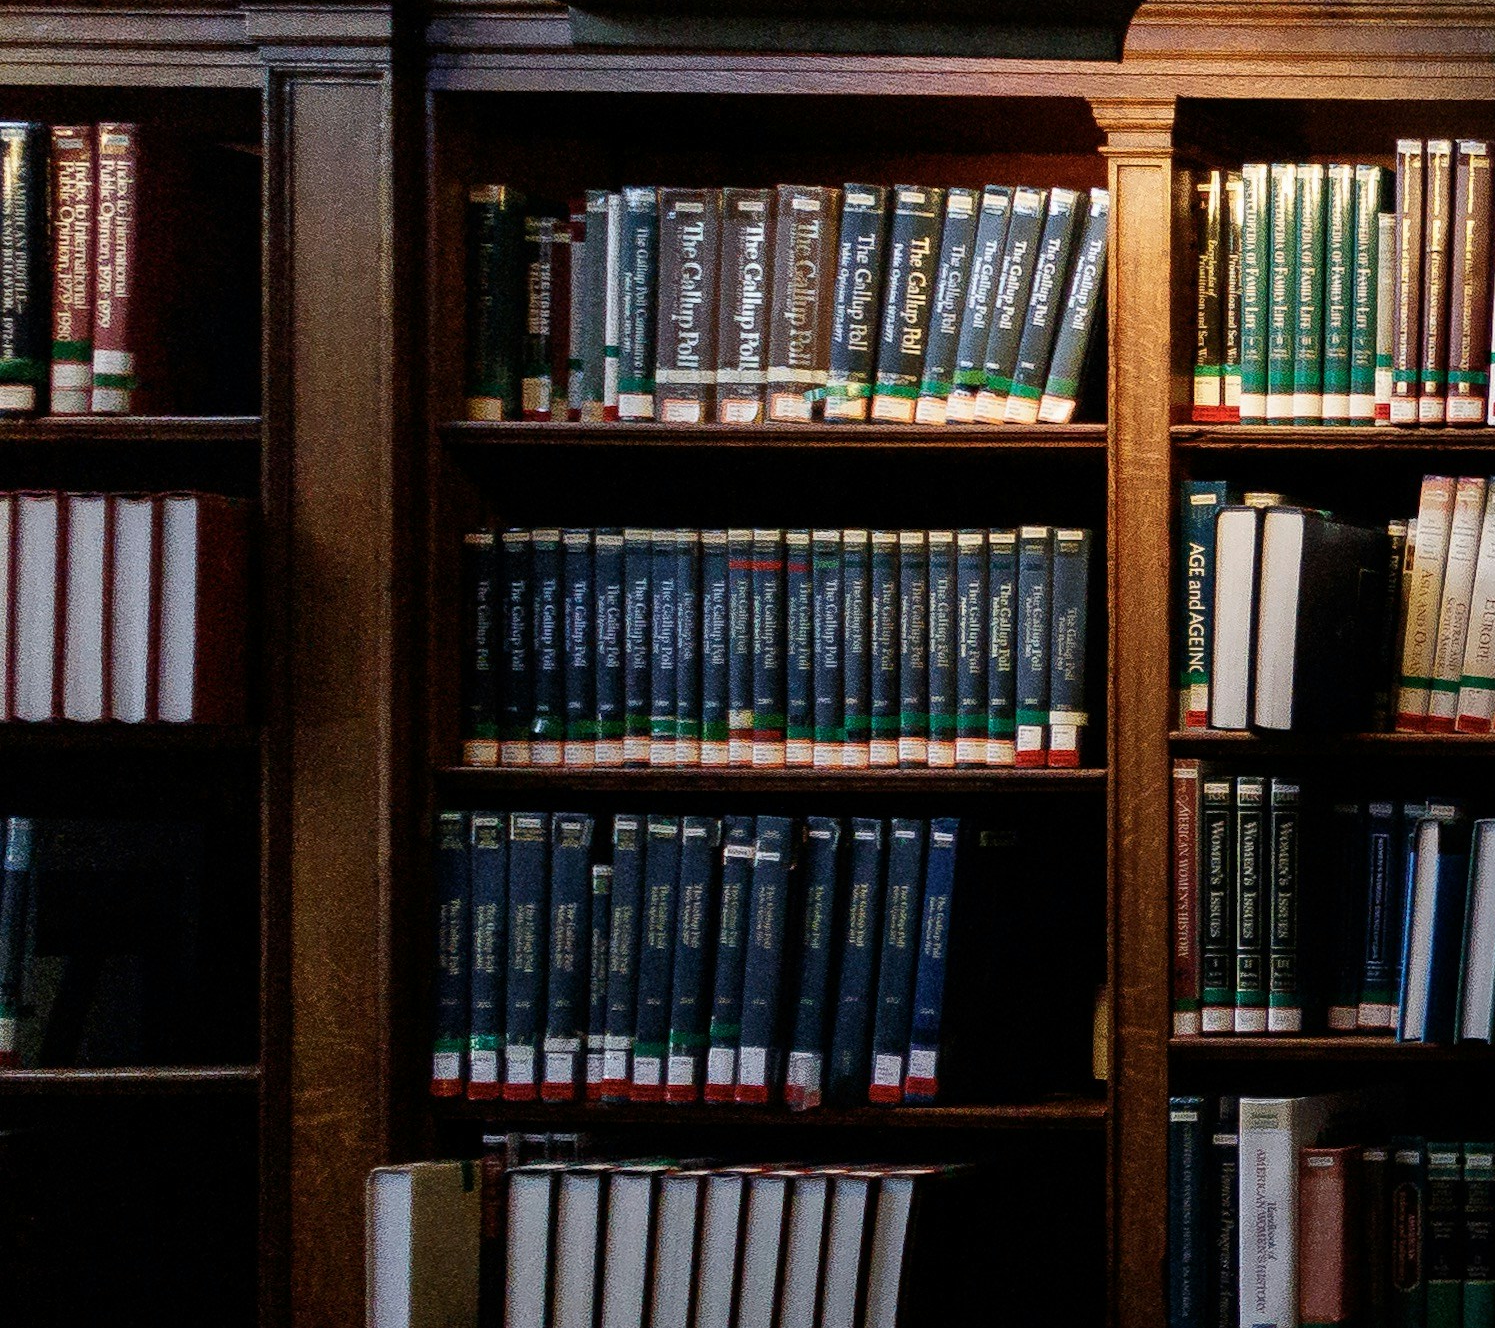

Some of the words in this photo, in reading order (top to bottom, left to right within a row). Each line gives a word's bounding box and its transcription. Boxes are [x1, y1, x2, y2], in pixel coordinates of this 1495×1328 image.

[57, 161, 75, 203] Public
[73, 161, 94, 200] Index
[99, 160, 115, 200] Public
[116, 160, 135, 197] Index
[15, 181, 27, 248] AMERICAN
[75, 204, 91, 218] to
[117, 200, 131, 213] to
[53, 206, 75, 271] Opinion,
[96, 202, 115, 262] Opinion,
[684, 222, 704, 259] The
[744, 223, 765, 259] The
[796, 222, 820, 257] The
[1045, 238, 1061, 260] The
[72, 220, 91, 310] International
[114, 216, 132, 298] International
[857, 234, 876, 267] The
[909, 238, 930, 267] The
[951, 245, 966, 267] The
[982, 241, 998, 263] The
[1012, 241, 1027, 264] The
[1087, 240, 1102, 262] The
[672, 262, 703, 327] Gallup
[734, 263, 764, 328] Gallup
[785, 261, 818, 326] Gallup
[846, 269, 872, 319] Gallup
[900, 272, 927, 323] Gallup
[942, 271, 962, 310] Gallup
[975, 266, 993, 303] Gallup
[1002, 266, 1022, 304] Gallup
[1036, 263, 1057, 302] Gallup
[1078, 265, 1097, 304] Gallup
[1245, 267, 1259, 303] FAMILY
[1274, 267, 1288, 302] FAMILY
[1356, 268, 1371, 303] FAMILY
[941, 313, 958, 334] Poll
[972, 305, 987, 328] Poll
[999, 306, 1015, 329] Poll
[1033, 304, 1049, 327] Poll
[1072, 306, 1088, 329] Poll
[1245, 307, 1259, 329] LIFE
[1274, 306, 1288, 329] LIFE
[1356, 308, 1371, 329] LIFE
[677, 332, 700, 367] Poll
[738, 331, 761, 371] Poll
[788, 331, 812, 366] Poll
[847, 321, 868, 352] Poll
[901, 327, 922, 355] Poll
[1190, 543, 1206, 578] AGE
[661, 578, 674, 601] The
[824, 579, 838, 601] The
[968, 581, 980, 603] The
[998, 583, 1011, 604] The
[1190, 581, 1206, 611] and
[1419, 569, 1435, 597] ASIA
[656, 603, 674, 643] Gallup
[822, 604, 838, 644] Gallup
[963, 606, 980, 646] Gallup
[994, 606, 1011, 646] Gallup
[1416, 600, 1430, 626] AND
[660, 647, 674, 669] Poll
[825, 646, 838, 668] Poll
[967, 651, 980, 673] Poll
[997, 649, 1011, 671] Poll
[1411, 631, 1427, 678] OCEAN
[1209, 891, 1225, 938] ISSUES
[1243, 892, 1257, 939] ISSUES
[1277, 892, 1293, 939] ISSUES
[1177, 913, 1192, 957] HISTORY
